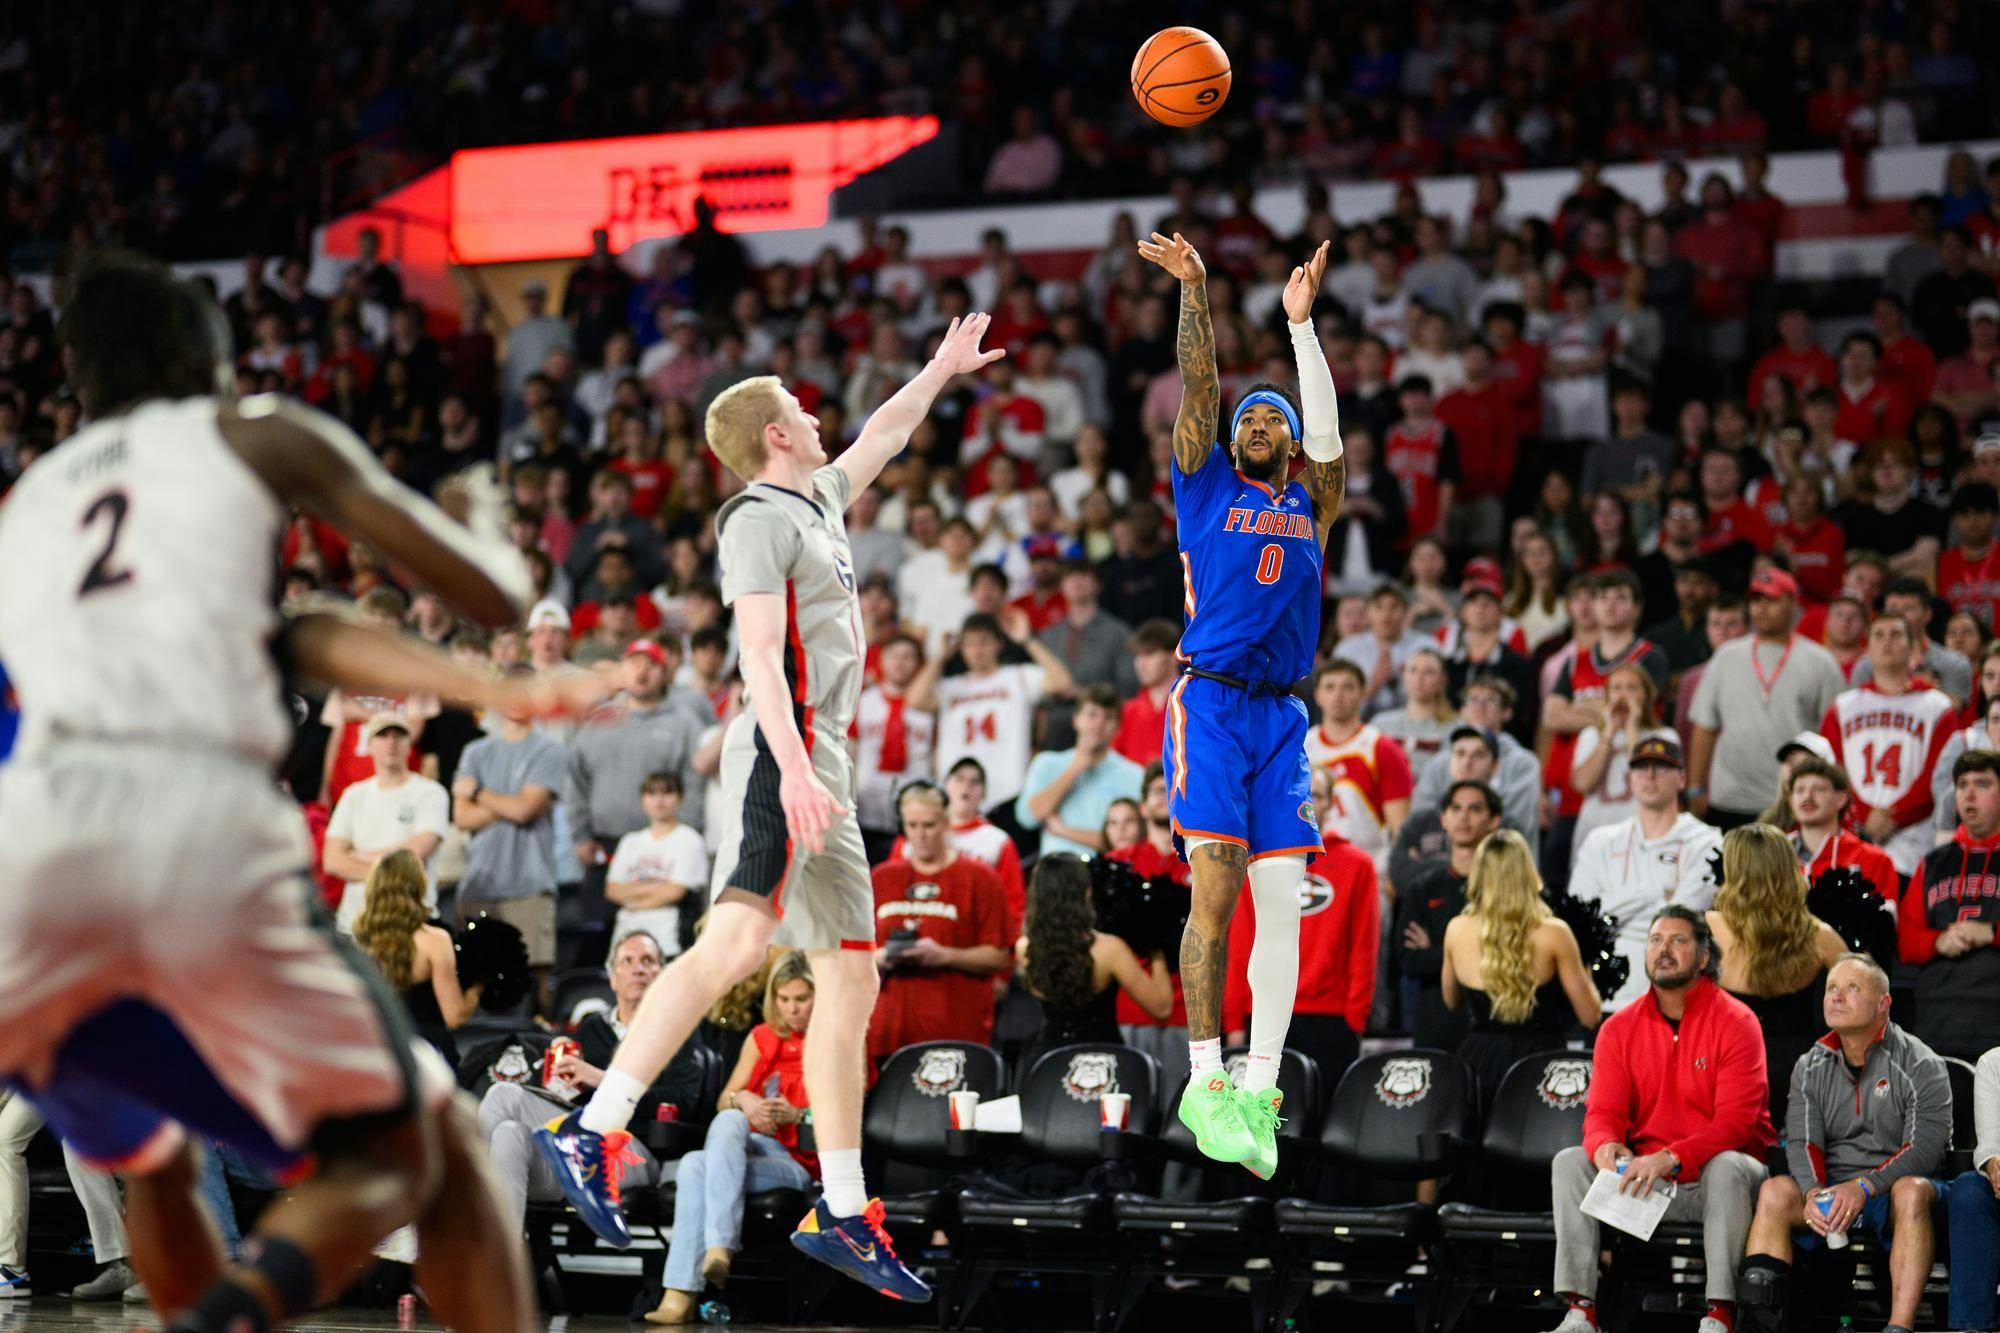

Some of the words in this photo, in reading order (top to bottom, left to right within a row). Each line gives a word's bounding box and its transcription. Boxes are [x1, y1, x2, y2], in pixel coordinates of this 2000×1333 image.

[78, 491, 134, 599] 2
[1223, 507, 1314, 541] FLORIDA
[1255, 543, 1285, 585] 0
[964, 711, 997, 745] 14
[1861, 741, 1902, 787] 14
